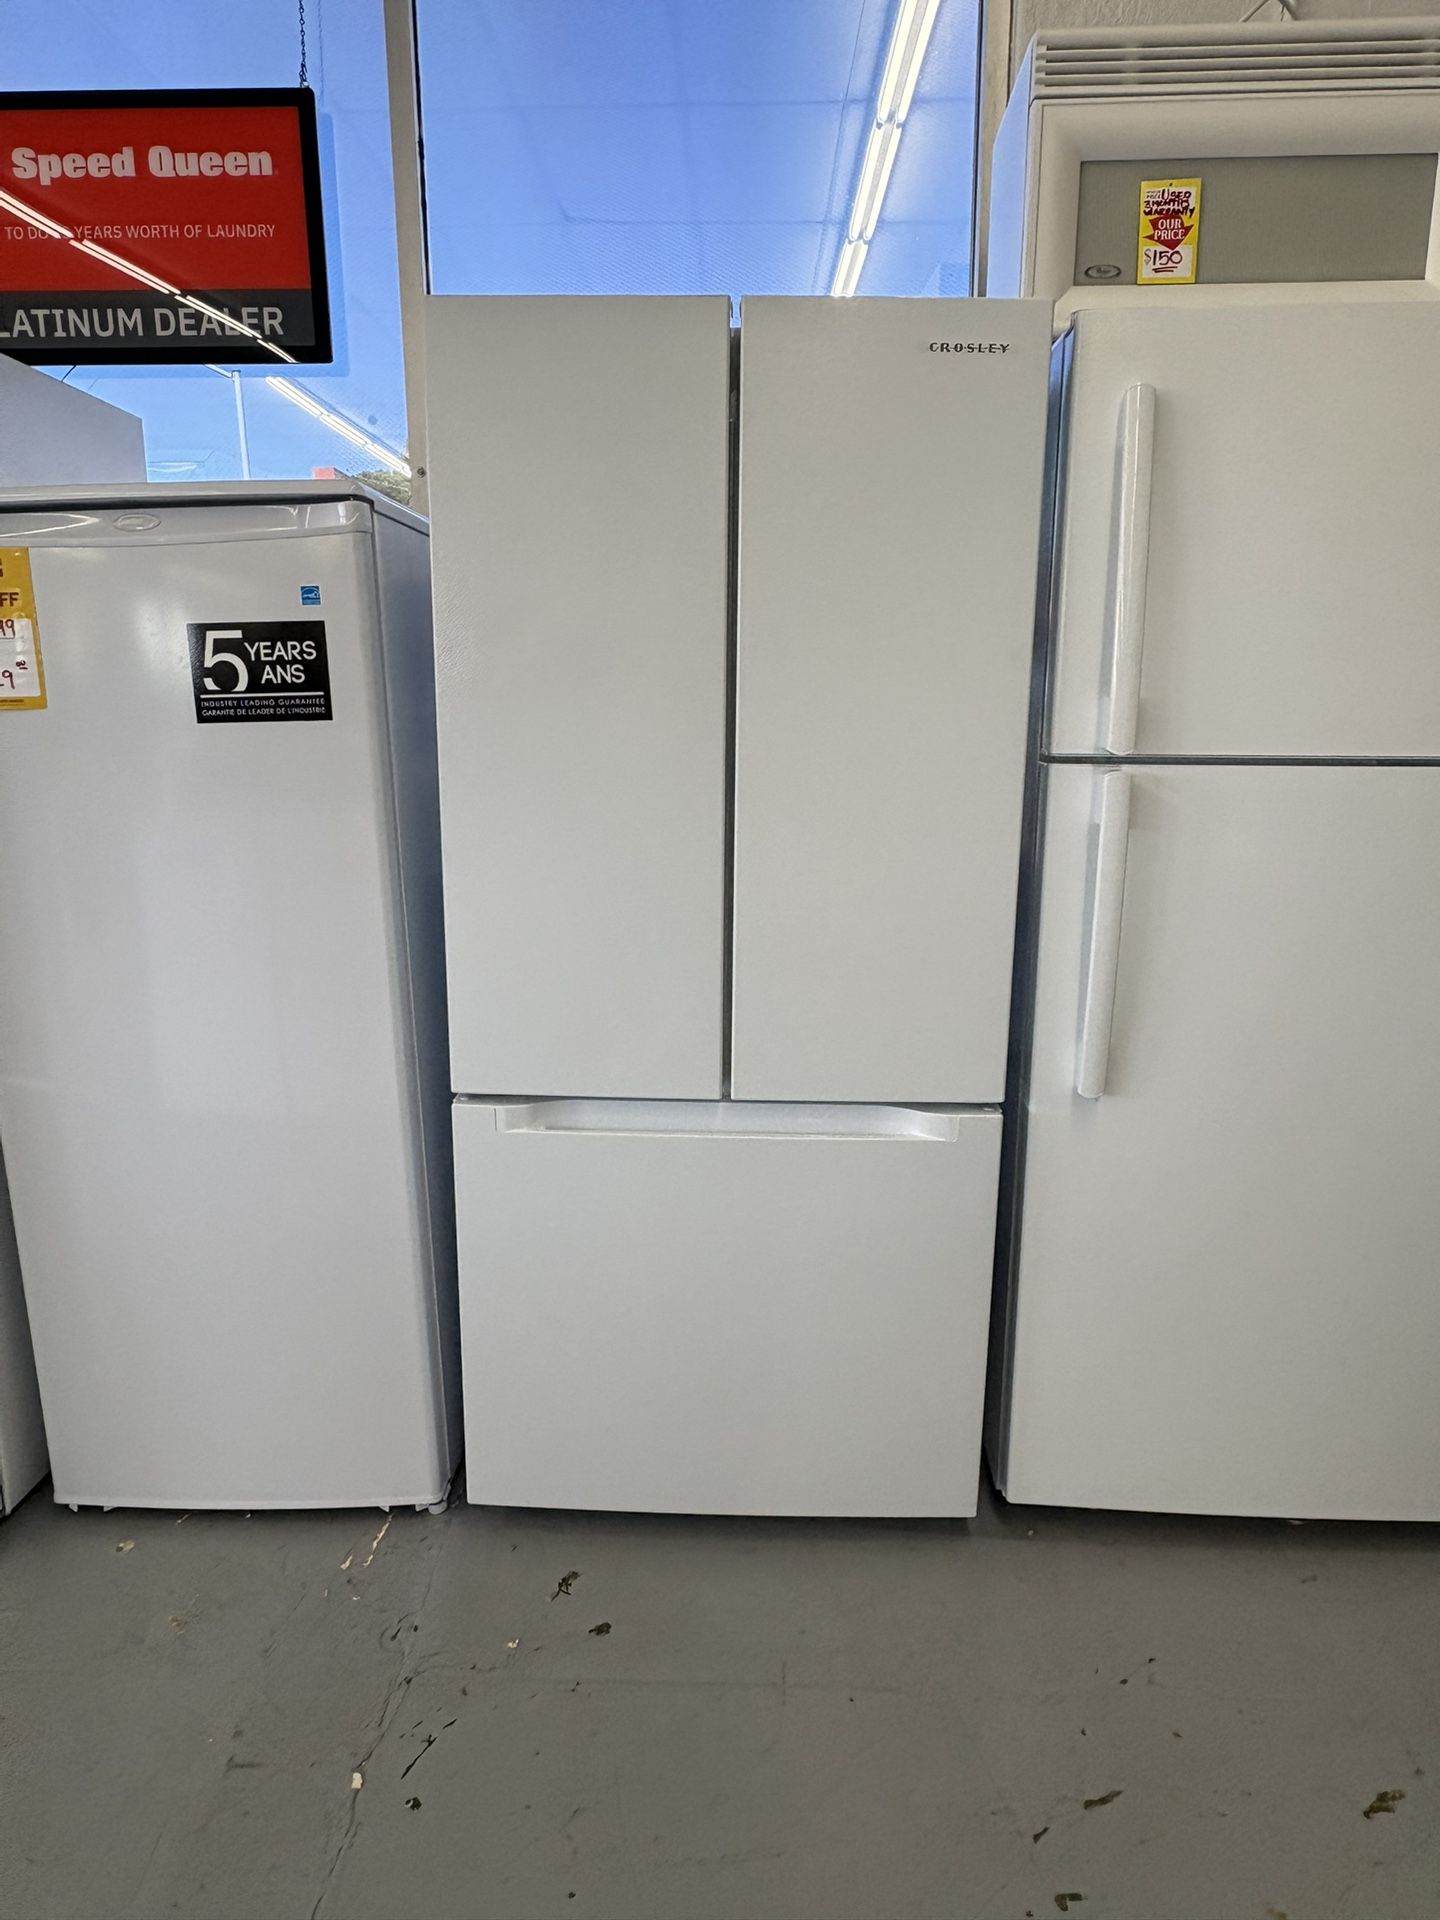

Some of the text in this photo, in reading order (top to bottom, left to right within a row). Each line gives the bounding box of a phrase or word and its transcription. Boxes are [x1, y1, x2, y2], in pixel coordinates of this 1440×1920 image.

[11, 145, 273, 186] Speed Queen
[4, 226, 24, 240] TO
[74, 225, 122, 240] YEARS
[125, 225, 179, 239] WORTH
[184, 224, 203, 238] OF
[207, 223, 275, 238] LAUNDRY
[1158, 219, 1181, 229] OUR
[1154, 229, 1185, 240] PRICE
[1144, 249, 1182, 265] $150
[154, 306, 285, 337] DEALER
[929, 342, 1010, 354] CROSLEY
[203, 630, 317, 692] 5 YEARS
[261, 664, 306, 684] ANS
[201, 698, 325, 708] INDUSTRY LEADING GUARANTEE
